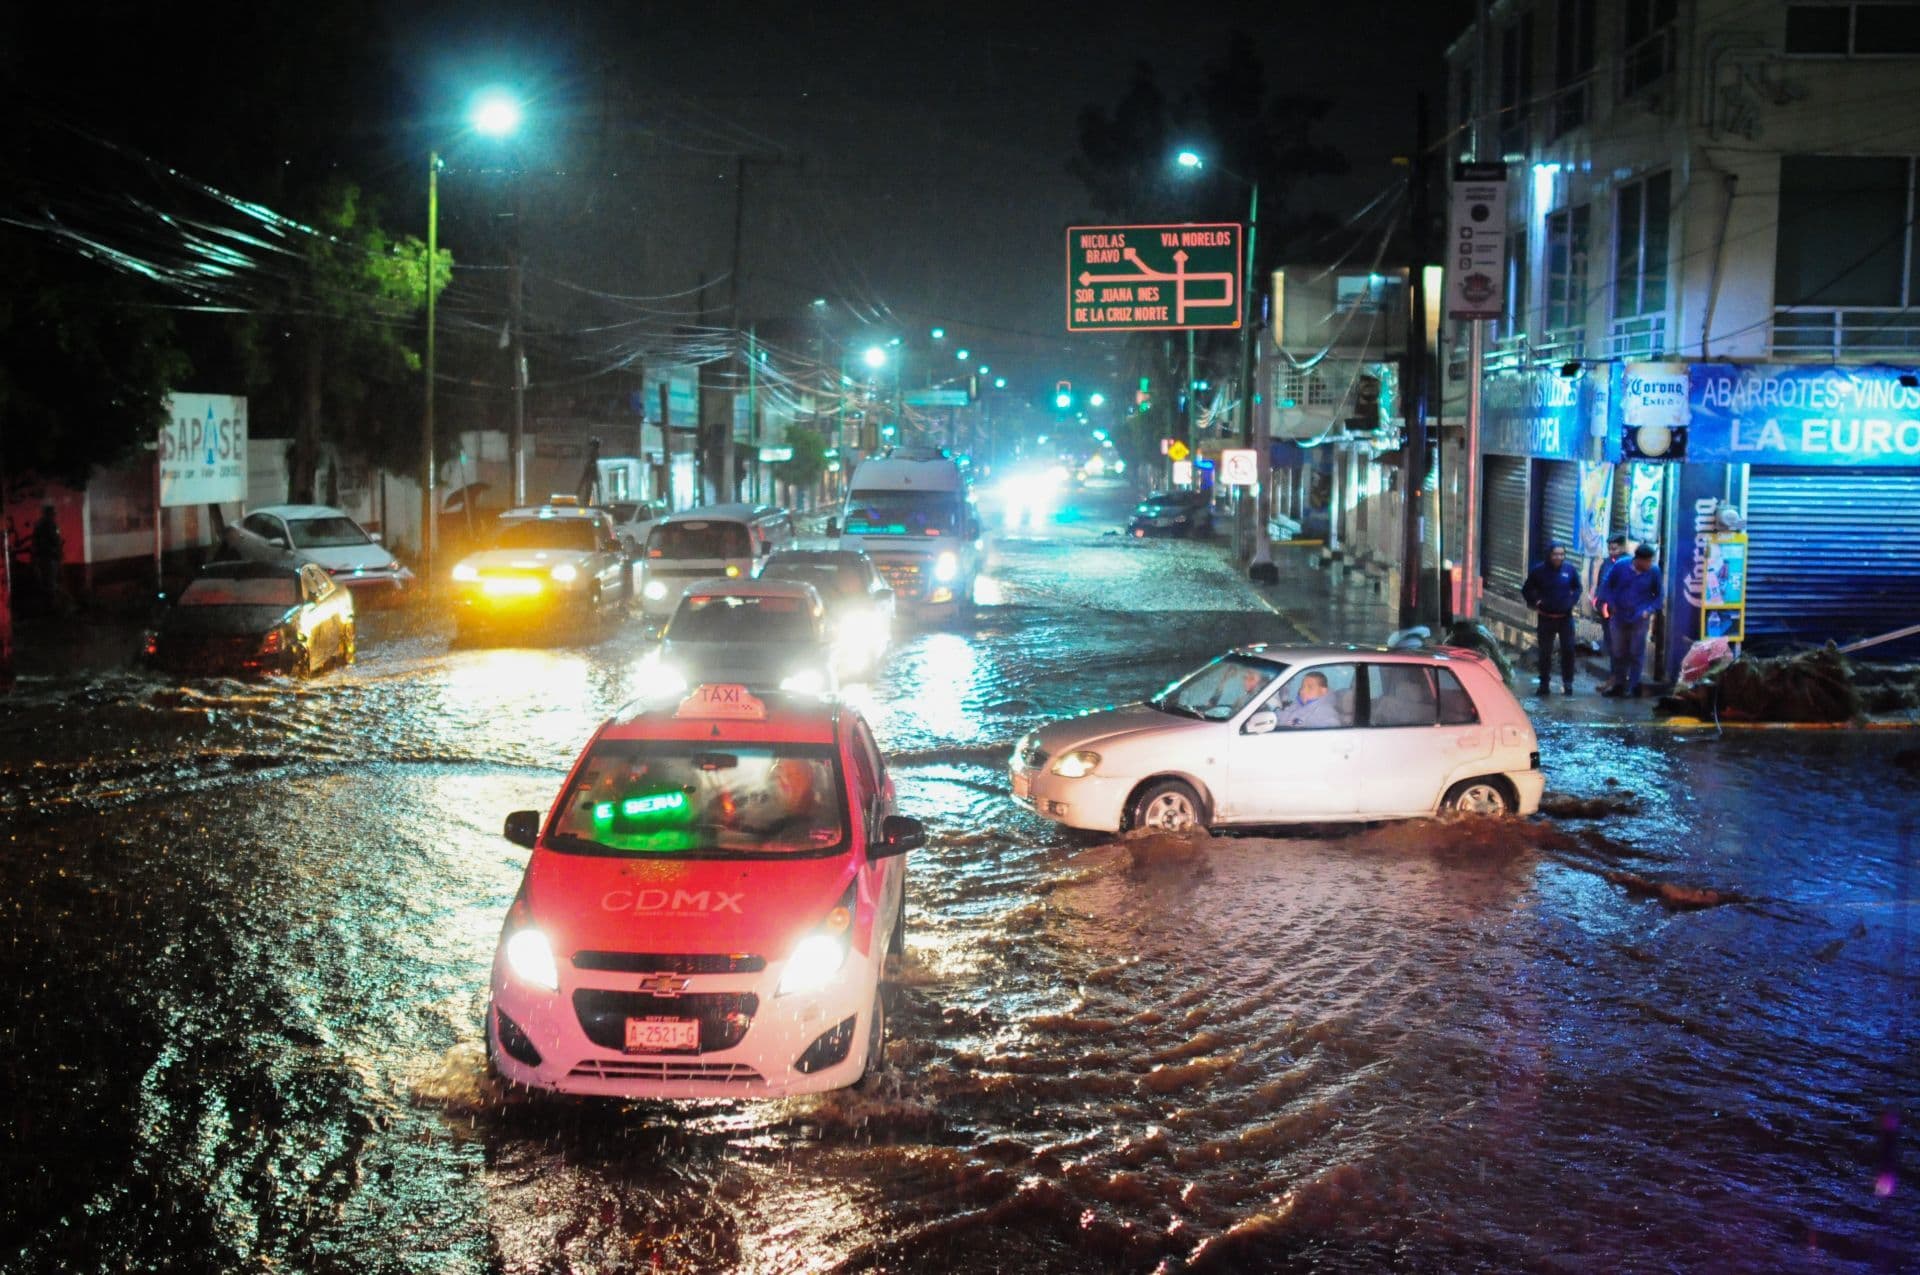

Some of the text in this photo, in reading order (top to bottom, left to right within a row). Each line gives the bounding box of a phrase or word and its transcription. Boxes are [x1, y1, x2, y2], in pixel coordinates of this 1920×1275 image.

[1081, 234, 1125, 248] NICOLAS
[1161, 231, 1231, 247] VIA MORELOS
[1086, 249, 1120, 264] BRAVO
[1075, 286, 1160, 303] SOR JUANA INES
[1075, 305, 1168, 322] DE LA CRUZ NORTE
[1631, 378, 1684, 395] Corona
[1853, 379, 1920, 410] VINOS
[160, 418, 242, 462] SAPASE
[1731, 418, 1920, 455] LA EURO
[601, 889, 745, 914] CDMX
